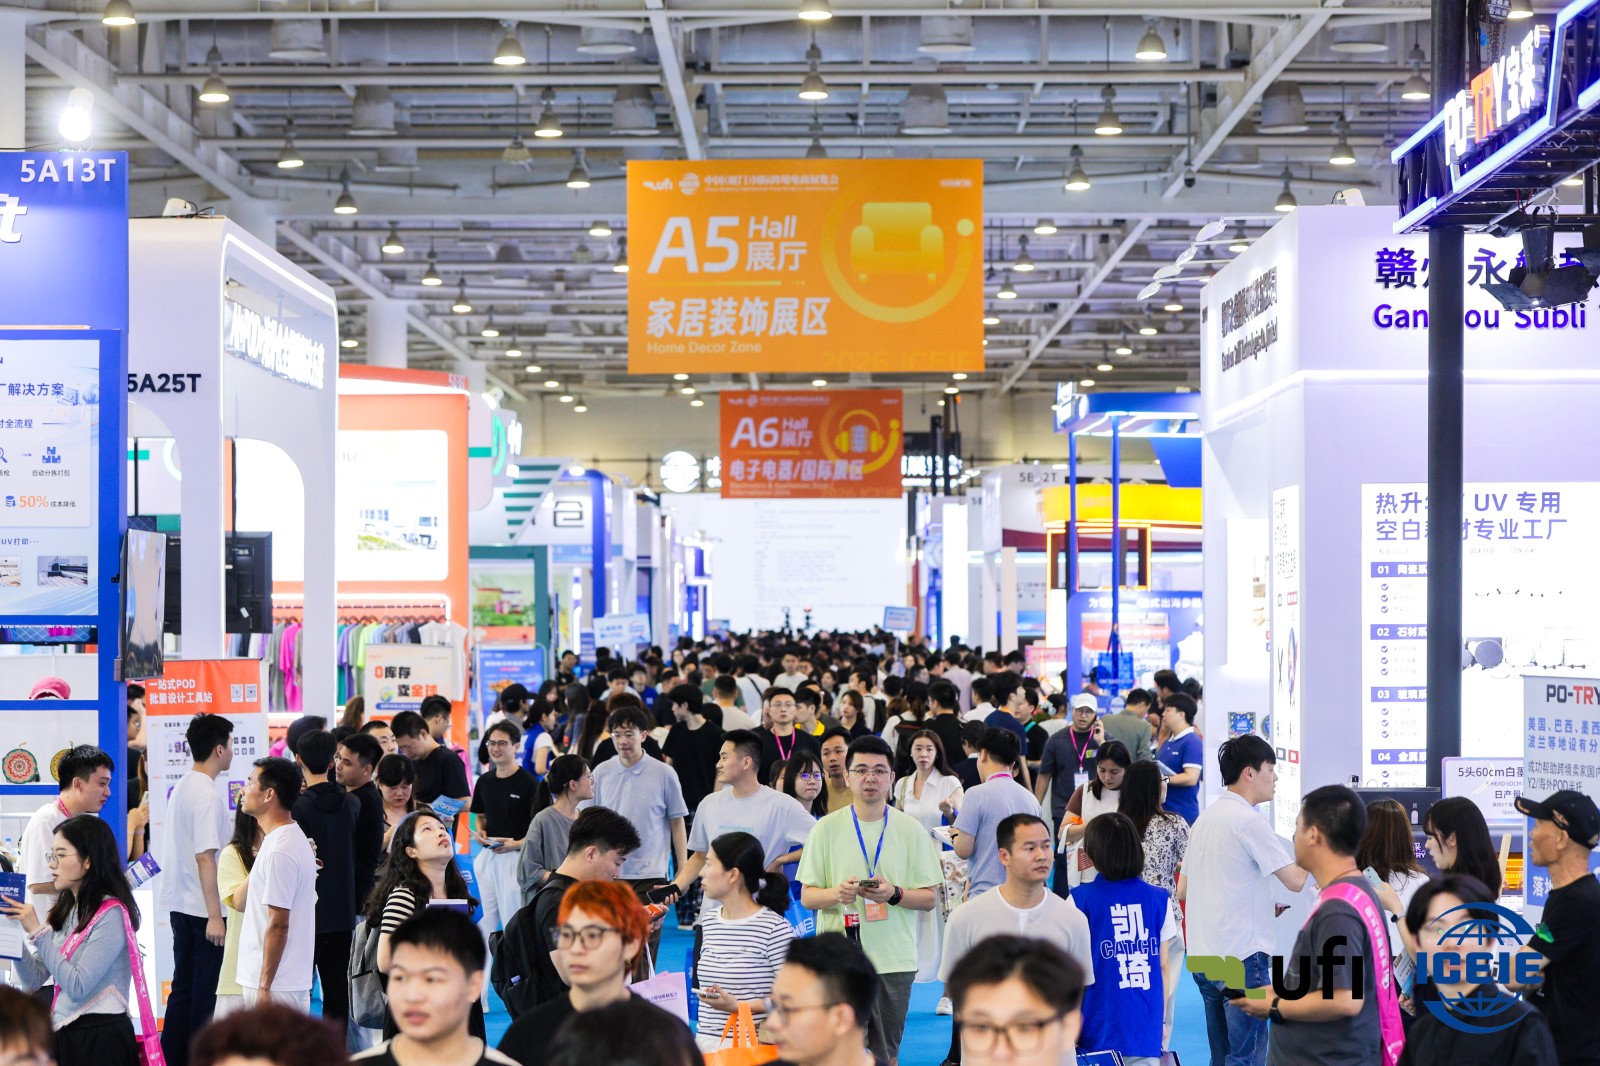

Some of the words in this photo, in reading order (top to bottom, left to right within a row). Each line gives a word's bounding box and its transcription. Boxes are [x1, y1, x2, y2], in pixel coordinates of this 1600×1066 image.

[1444, 56, 1505, 165] PO-TRY
[20, 158, 117, 183] 5A13T
[647, 216, 740, 274] A5
[749, 215, 798, 239] Hall
[746, 241, 807, 272] 展厅
[646, 297, 831, 338] 家居装饰展区
[1374, 303, 1500, 328] Ganou
[647, 342, 685, 354] Home
[688, 342, 726, 354] Decor
[730, 341, 762, 354] Zone
[128, 373, 202, 393] 5A25T
[730, 417, 779, 448] A6
[782, 418, 809, 430] Hall
[781, 431, 814, 447] 展厅
[729, 459, 866, 481] 电子电器/国际展区
[1019, 472, 1057, 482] 5B2T
[20, 495, 49, 508] 50%
[1376, 492, 1429, 514] 热升
[1474, 493, 1508, 512] UV
[1516, 492, 1561, 513] 专用
[1376, 518, 1567, 541] 空白专业工厂
[1377, 566, 1390, 574] 01
[1377, 628, 1390, 637] 02
[149, 679, 196, 692] 一站式POD
[1377, 690, 1390, 699] 03
[149, 692, 213, 705] 批量设计工具站
[1377, 752, 1391, 761] 04
[1099, 936, 1160, 960] CATCH
[1109, 903, 1152, 991] 凯琦
